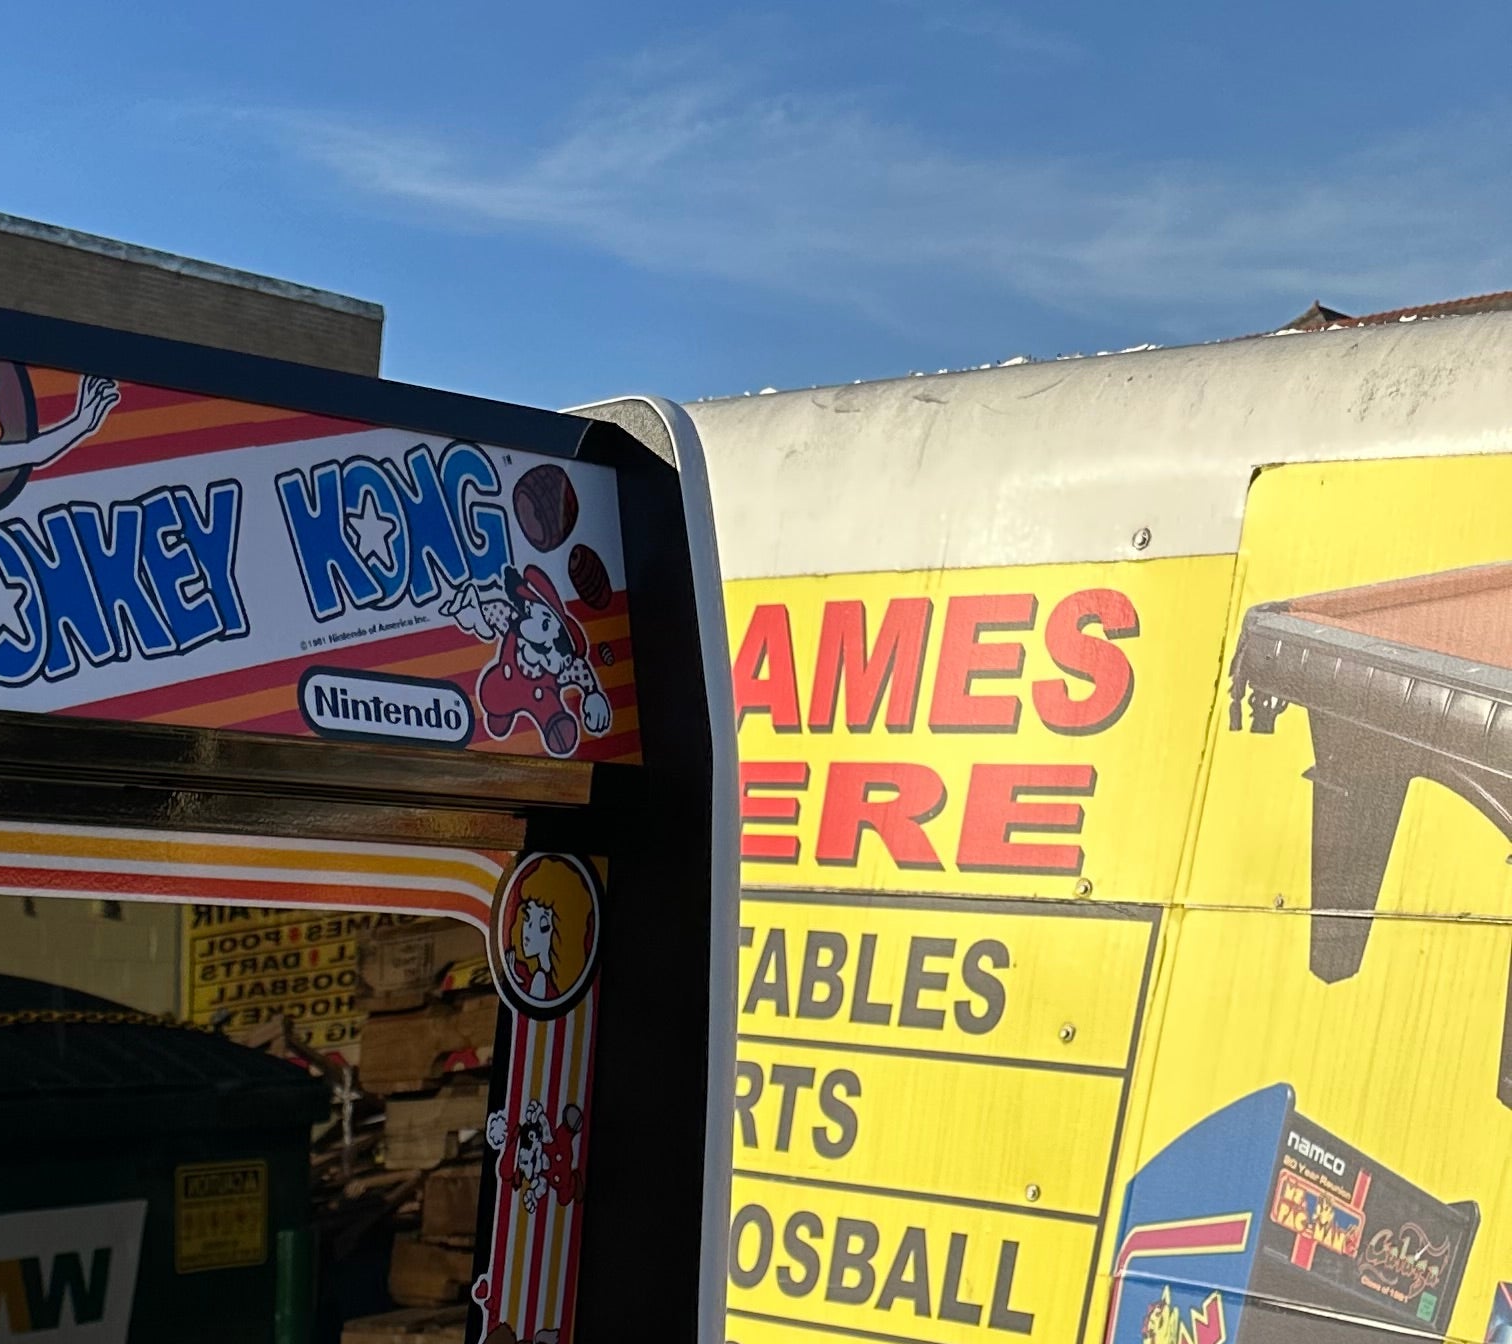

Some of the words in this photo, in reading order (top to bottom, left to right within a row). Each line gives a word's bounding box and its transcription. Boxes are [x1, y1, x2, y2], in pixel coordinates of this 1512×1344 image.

[278, 440, 515, 623] KONG
[329, 628, 368, 643] Nintendo
[378, 618, 413, 633] America
[733, 588, 1141, 736] AMES
[314, 685, 462, 731] Nintendo
[738, 762, 1097, 874] ERE
[733, 1059, 863, 1162] RTS
[1287, 1130, 1346, 1176] namco
[1298, 1162, 1320, 1182] Year
[1319, 1173, 1352, 1201] Reunion
[729, 1203, 1036, 1336] OSBALL
